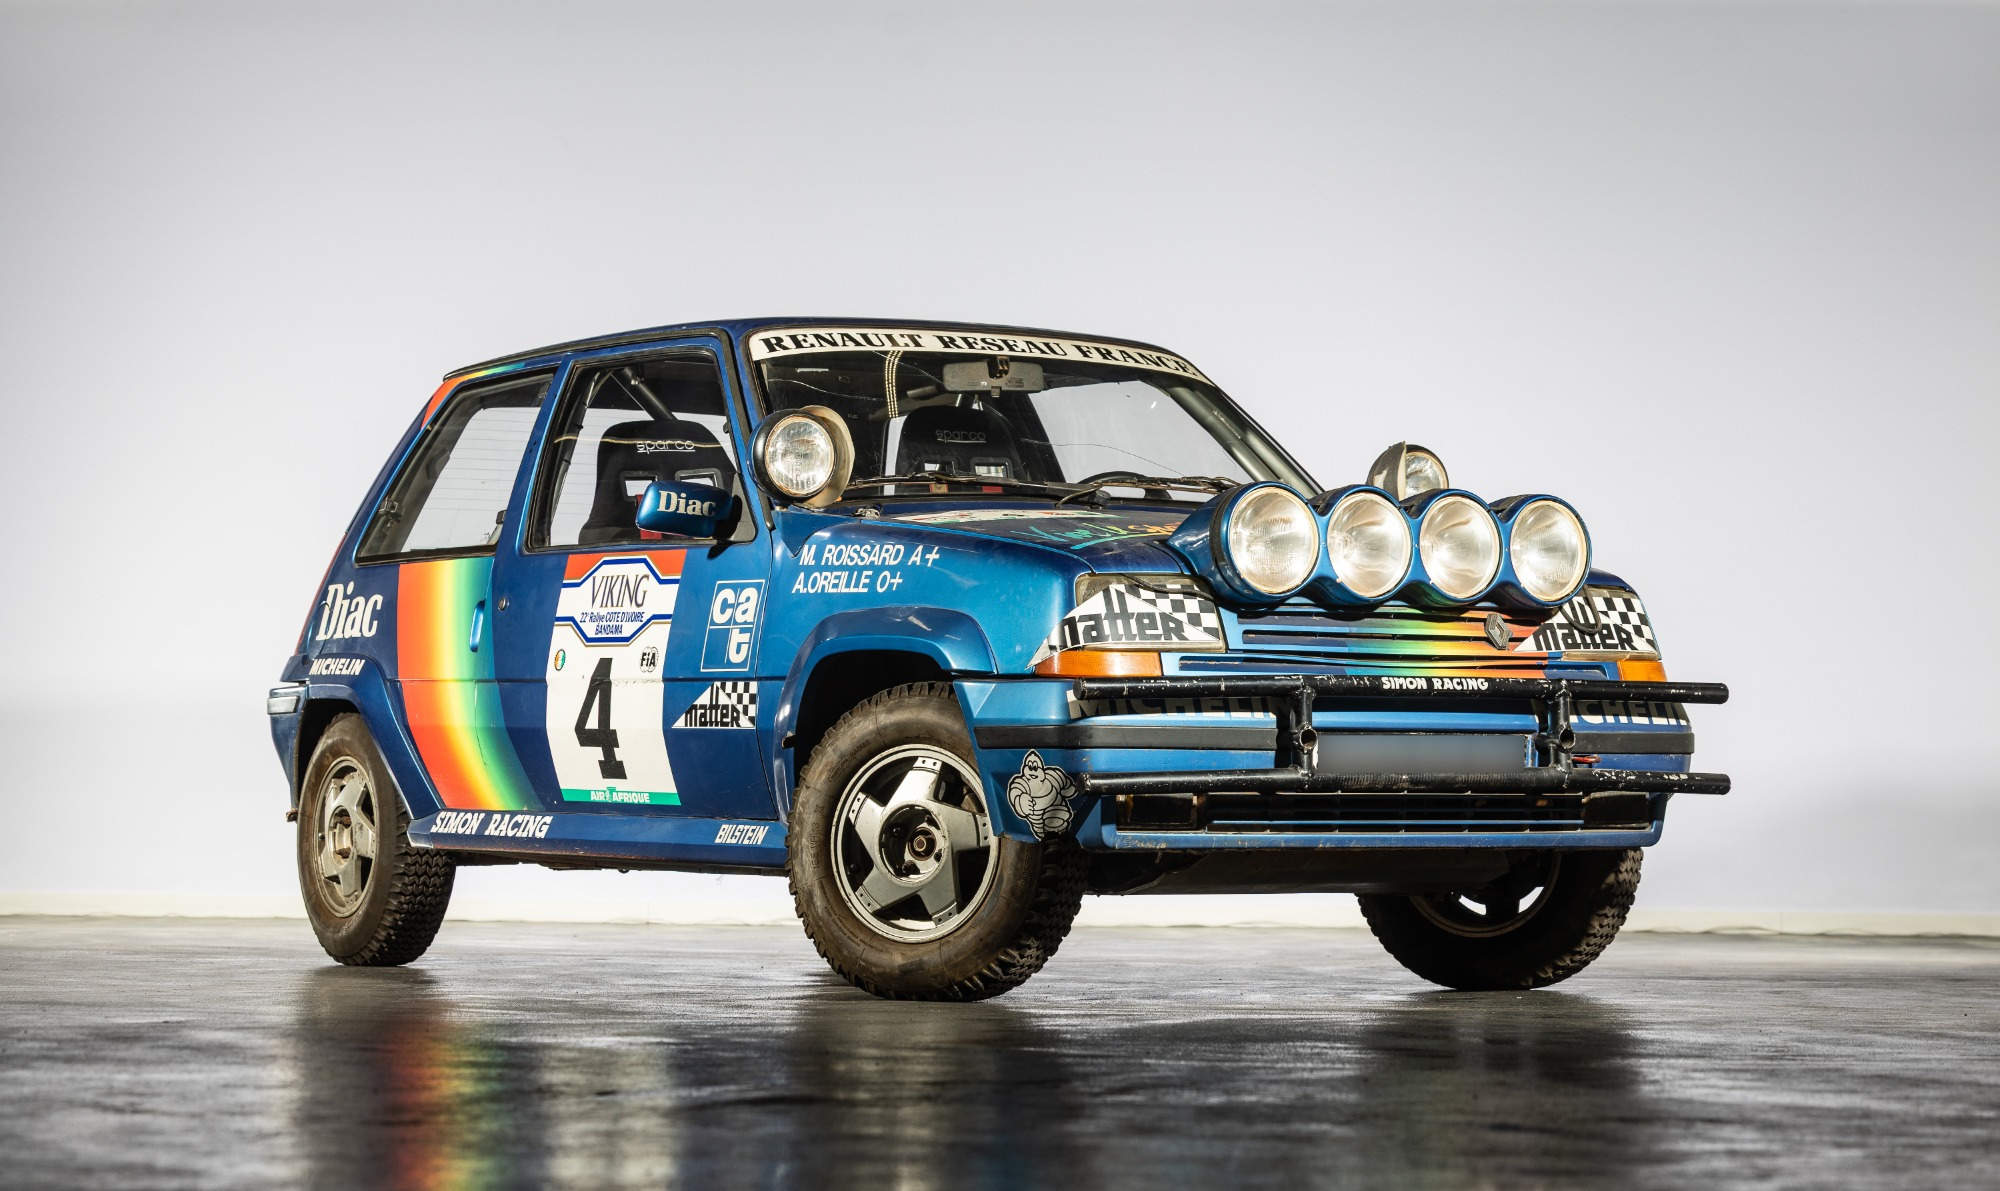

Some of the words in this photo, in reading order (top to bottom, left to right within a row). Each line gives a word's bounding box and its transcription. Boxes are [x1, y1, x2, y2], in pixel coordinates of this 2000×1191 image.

[759, 333, 925, 353] RENAULT
[932, 335, 1068, 357] RESEAU
[1071, 344, 1198, 376] FRANCE
[657, 490, 717, 517] Diac
[799, 544, 816, 566] M.
[821, 544, 905, 566] ROISSARD
[592, 574, 649, 608] VIKING
[791, 570, 873, 593] A.OREILLE
[316, 581, 383, 641] Diac
[594, 624, 623, 635] BANDAMA
[309, 658, 366, 676] MICHELIN
[1380, 676, 1428, 690] SIMON
[1431, 677, 1489, 691] RACING
[575, 658, 628, 779] 4
[590, 790, 606, 801] AIR
[612, 791, 650, 803] AFRIQUE
[430, 811, 485, 835] SIMON
[484, 813, 553, 839] RACING
[714, 824, 769, 845] BILSTEIN
